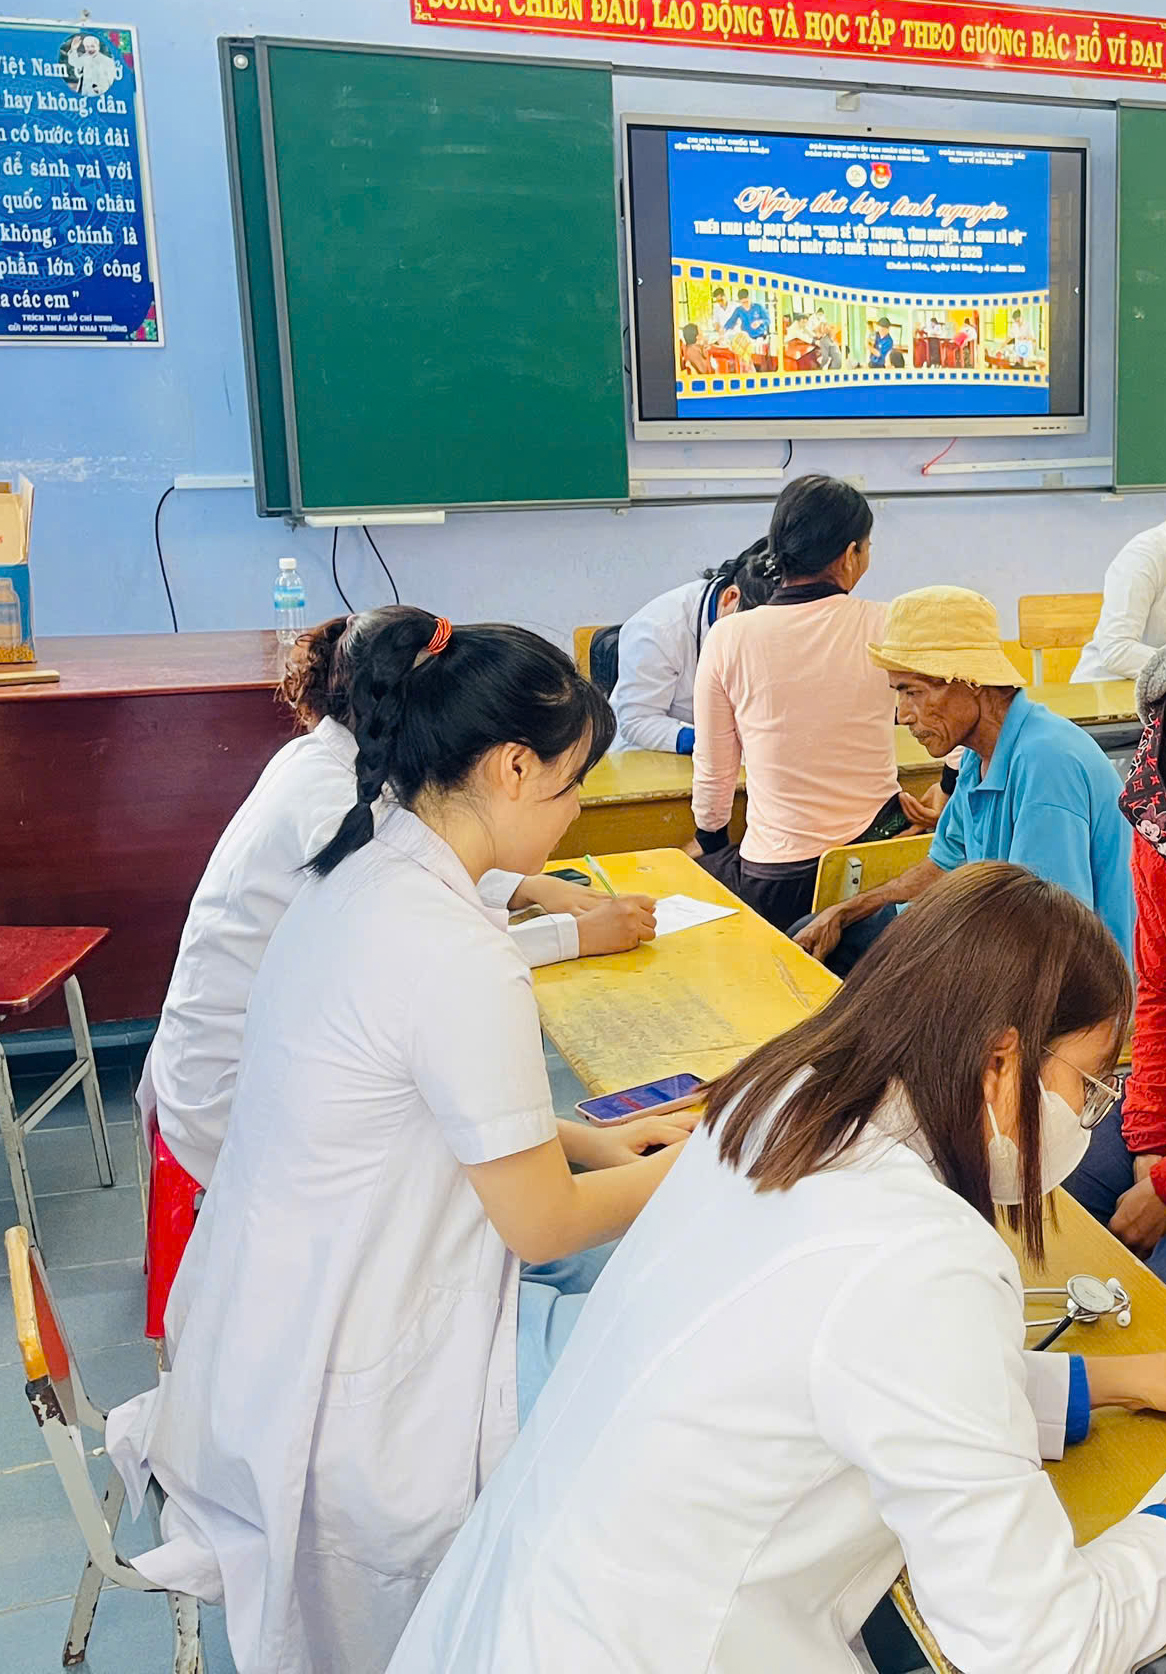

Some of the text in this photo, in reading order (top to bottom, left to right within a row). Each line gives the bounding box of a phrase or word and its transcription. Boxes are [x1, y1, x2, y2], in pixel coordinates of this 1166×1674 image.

[652, 0, 696, 31] LAO
[702, 0, 764, 41] ĐỘNG
[768, 2, 801, 39] VÀ
[804, 11, 850, 48] HỌC
[855, 9, 896, 52] TẬP
[901, 20, 955, 51] THEO
[961, 22, 1026, 57] GƯƠNG
[1032, 25, 1070, 61] BÁC
[1075, 20, 1102, 63] HỒ
[1131, 39, 1163, 73] ĐẠI
[31, 57, 69, 78] Nam
[4, 89, 128, 118] hay không, dân
[10, 123, 30, 143] có
[33, 124, 73, 144] bước
[77, 127, 101, 146] tới
[104, 127, 130, 147] đài
[3, 150, 133, 180] để sánh vai với
[3, 187, 136, 214] quốc năm châu
[733, 186, 809, 222] Ngày
[936, 201, 1008, 228] nguyện
[0, 223, 138, 249] không, chính là
[47, 257, 75, 276] lớn
[83, 255, 94, 277] ở
[103, 258, 142, 283] công
[12, 289, 42, 308] các
